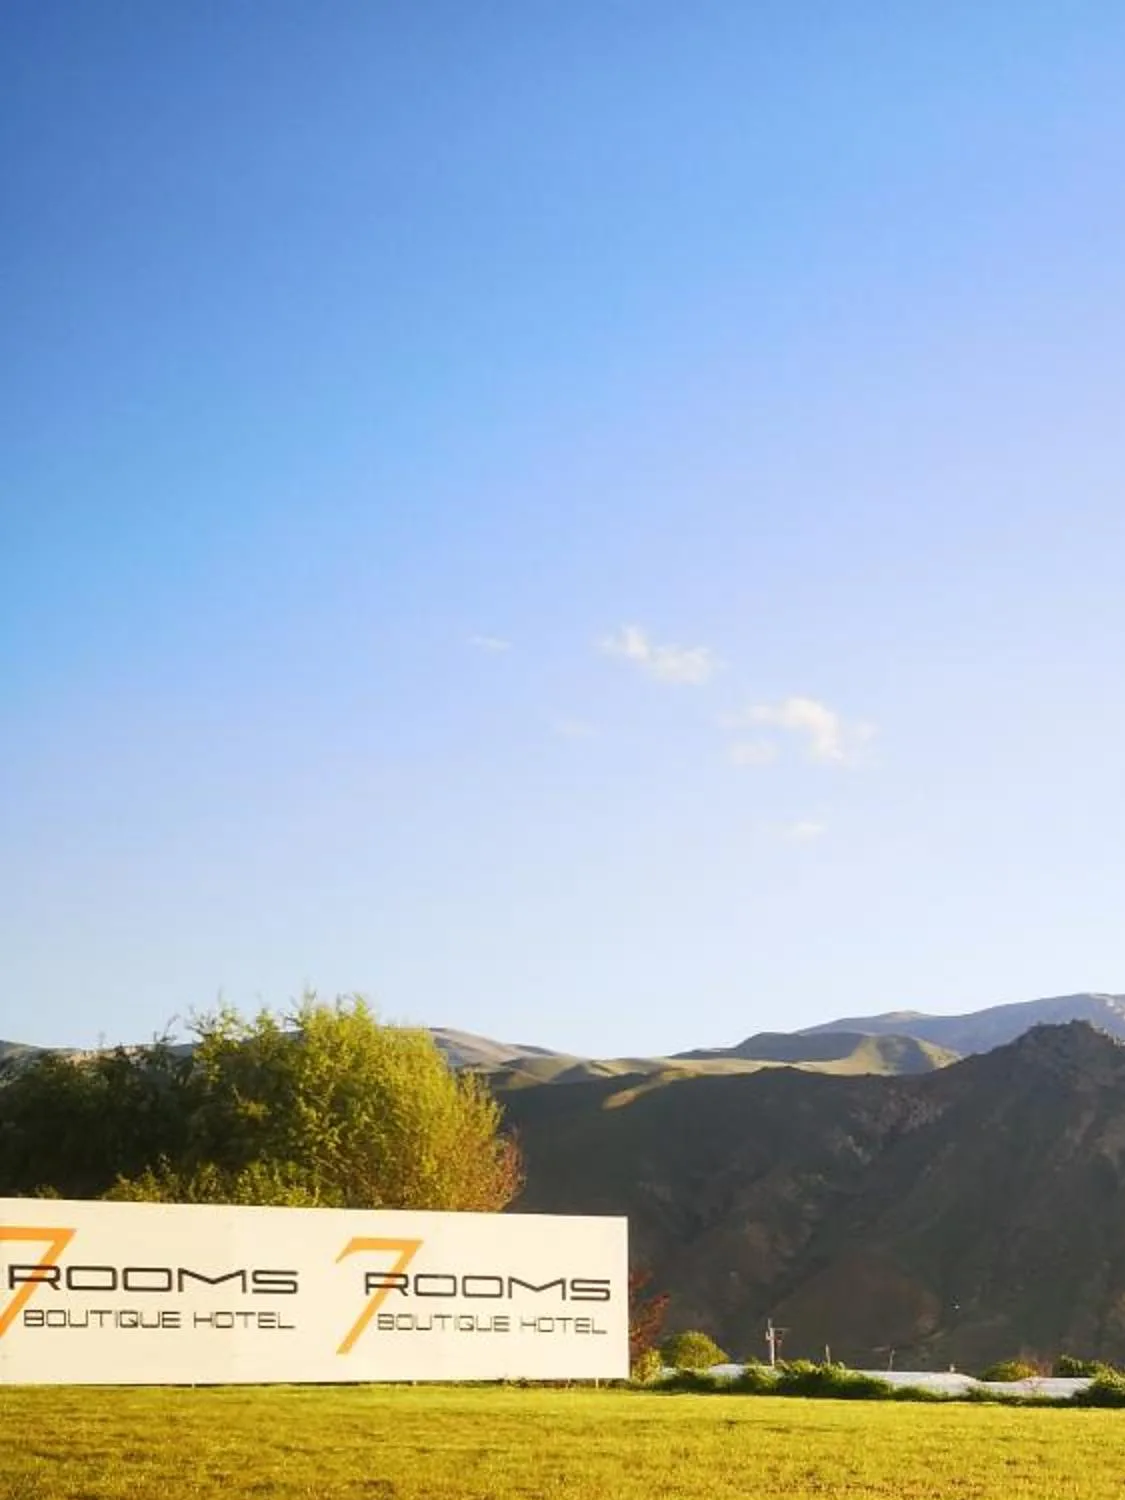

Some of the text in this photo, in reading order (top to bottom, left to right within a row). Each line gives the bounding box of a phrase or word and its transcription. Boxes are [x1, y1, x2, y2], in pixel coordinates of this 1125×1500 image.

[0, 1226, 299, 1339] 7 ROOMS
[335, 1236, 611, 1356] 7 ROOMS
[23, 1309, 296, 1330] BOUTIQUE HOTEL
[377, 1313, 607, 1335] BOUTIQUE HOTEL
